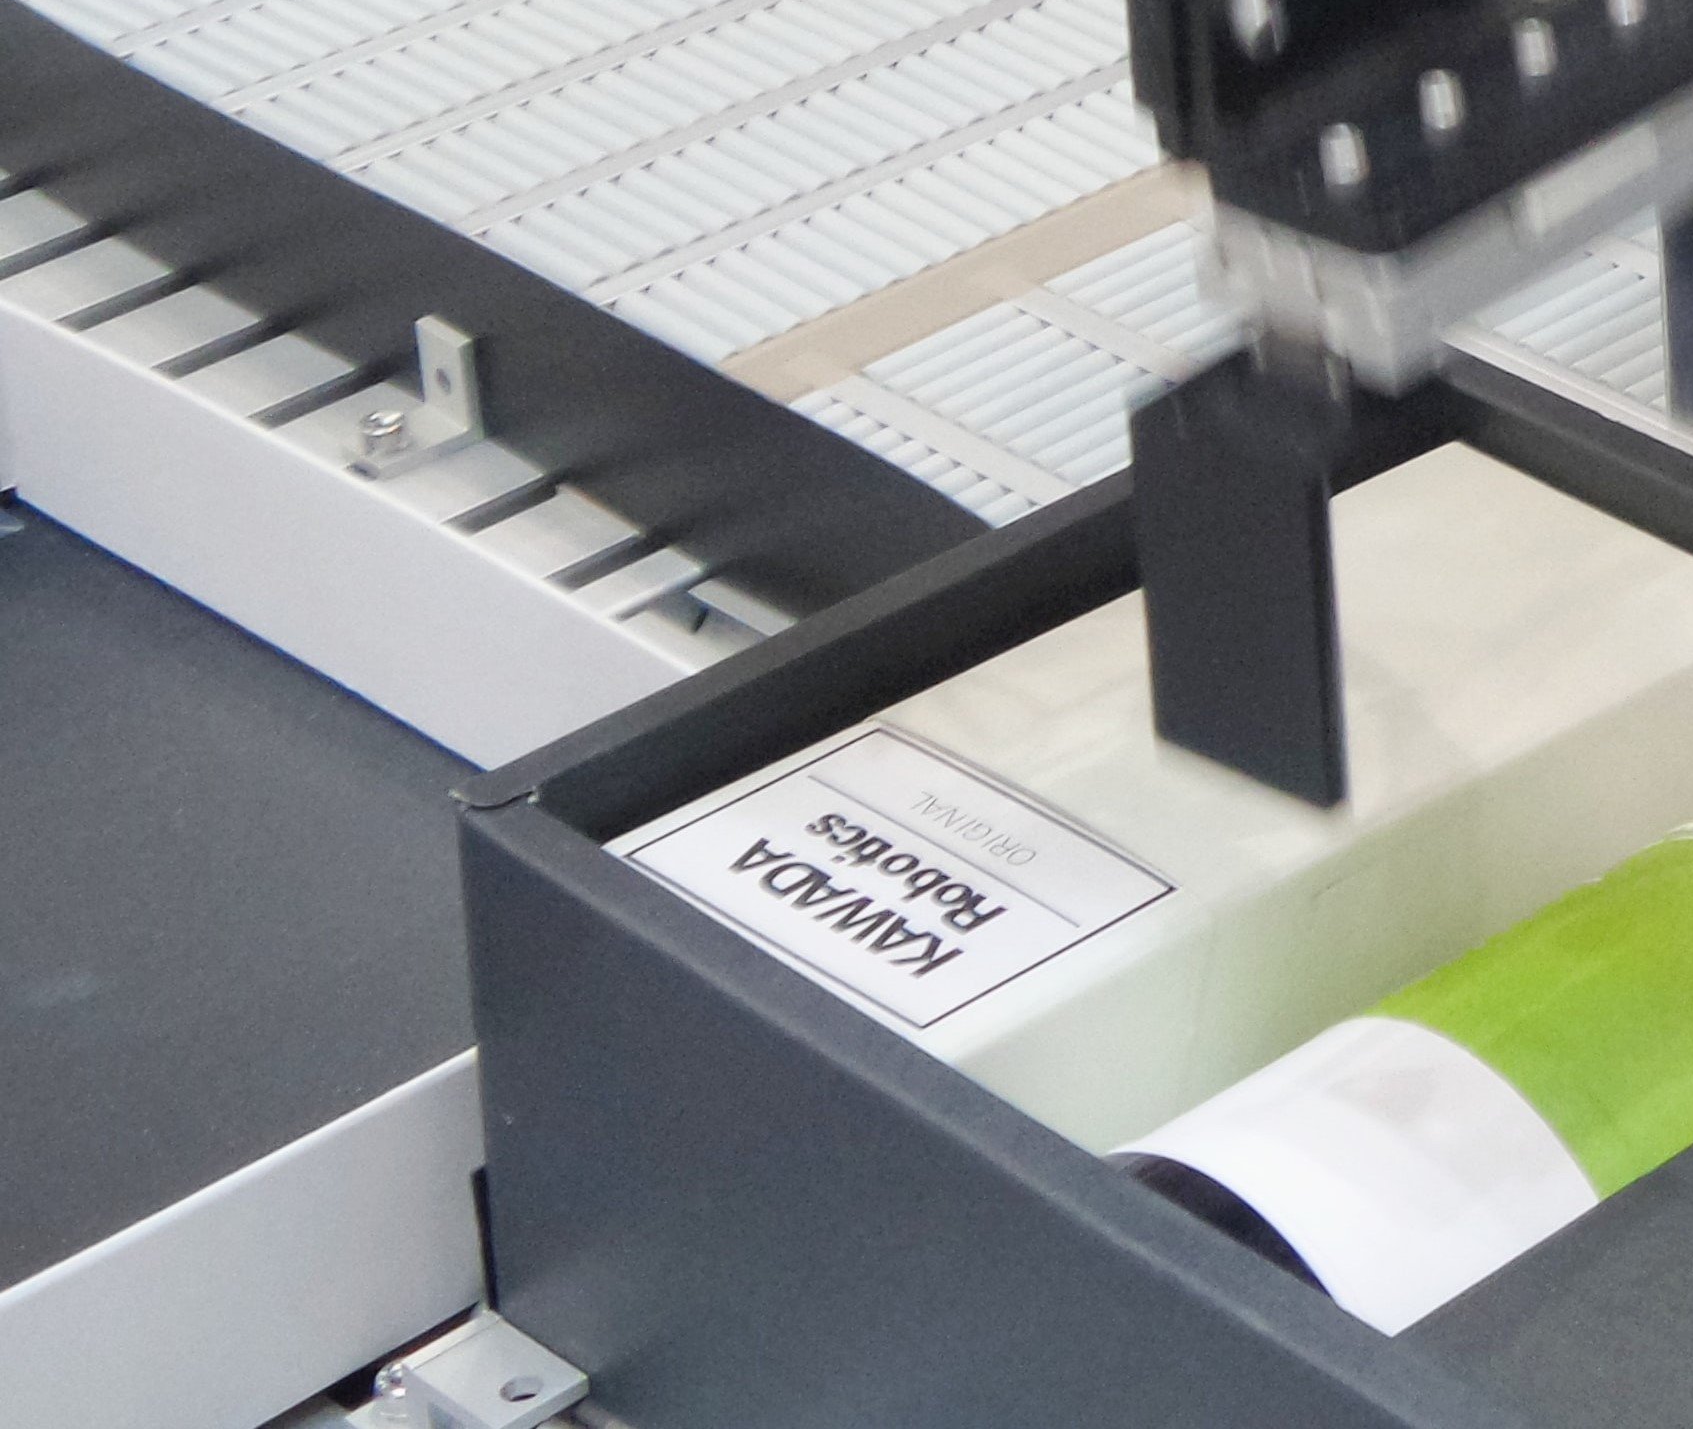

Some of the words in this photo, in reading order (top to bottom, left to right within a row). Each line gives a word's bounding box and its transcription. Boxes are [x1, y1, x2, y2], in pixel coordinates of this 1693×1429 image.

[805, 813, 1008, 936] Robotics
[910, 790, 1037, 867] ORIGINAL
[729, 837, 965, 980] KAWADA
